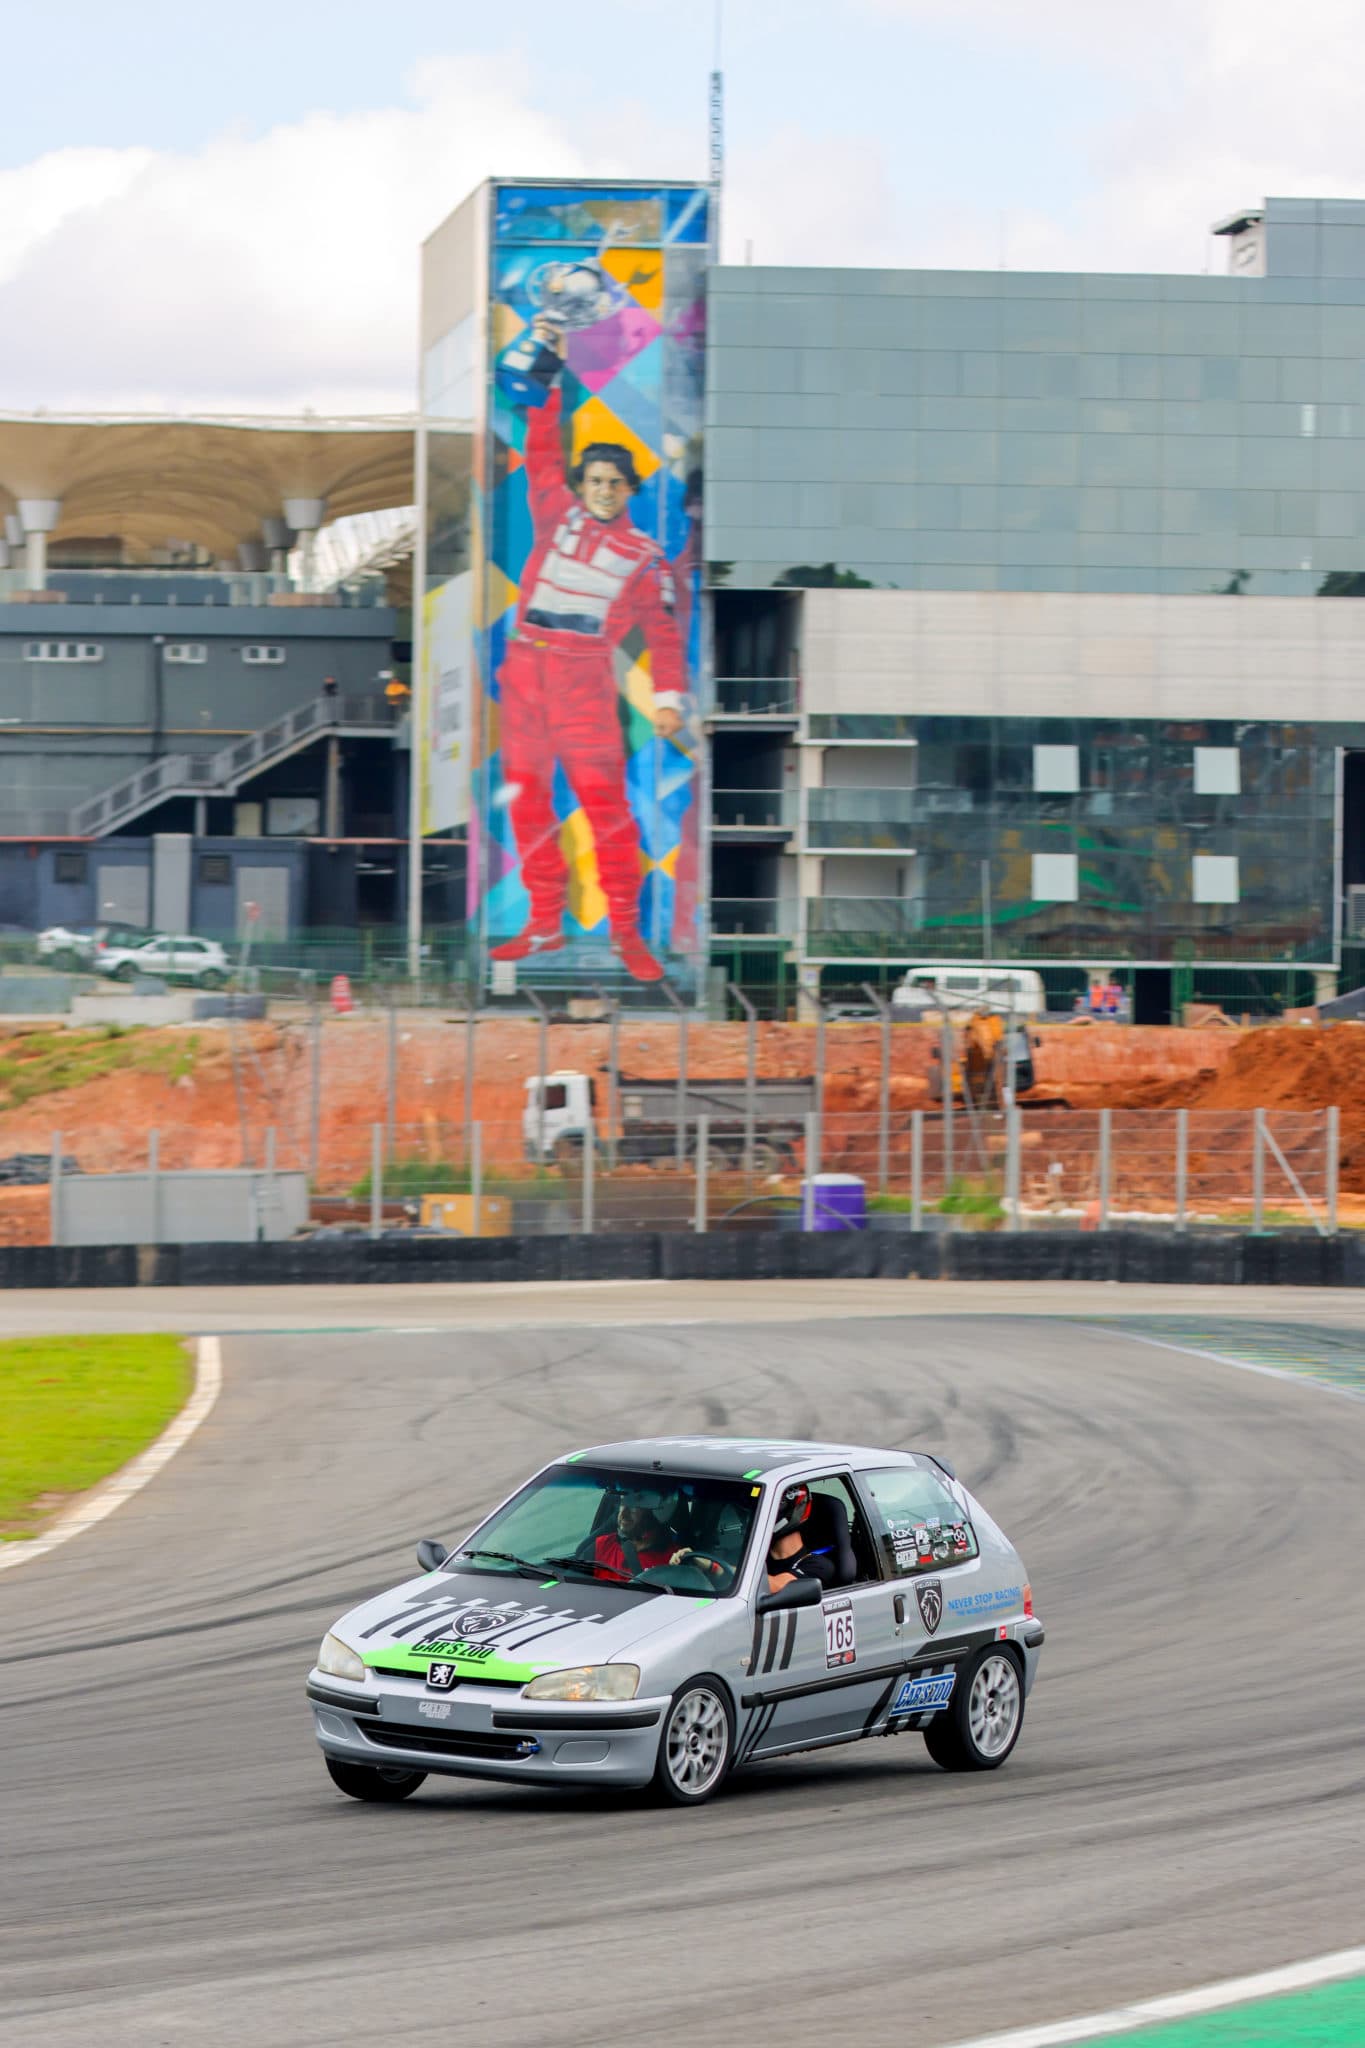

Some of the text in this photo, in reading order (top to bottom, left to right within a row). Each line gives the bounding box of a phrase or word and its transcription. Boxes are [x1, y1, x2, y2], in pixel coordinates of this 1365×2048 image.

[948, 1597, 973, 1610] NEVER
[974, 1592, 993, 1605] STOP
[995, 1587, 1020, 1599] RACING
[827, 1615, 853, 1651] 165
[411, 1638, 496, 1659] CAR'S ZOO
